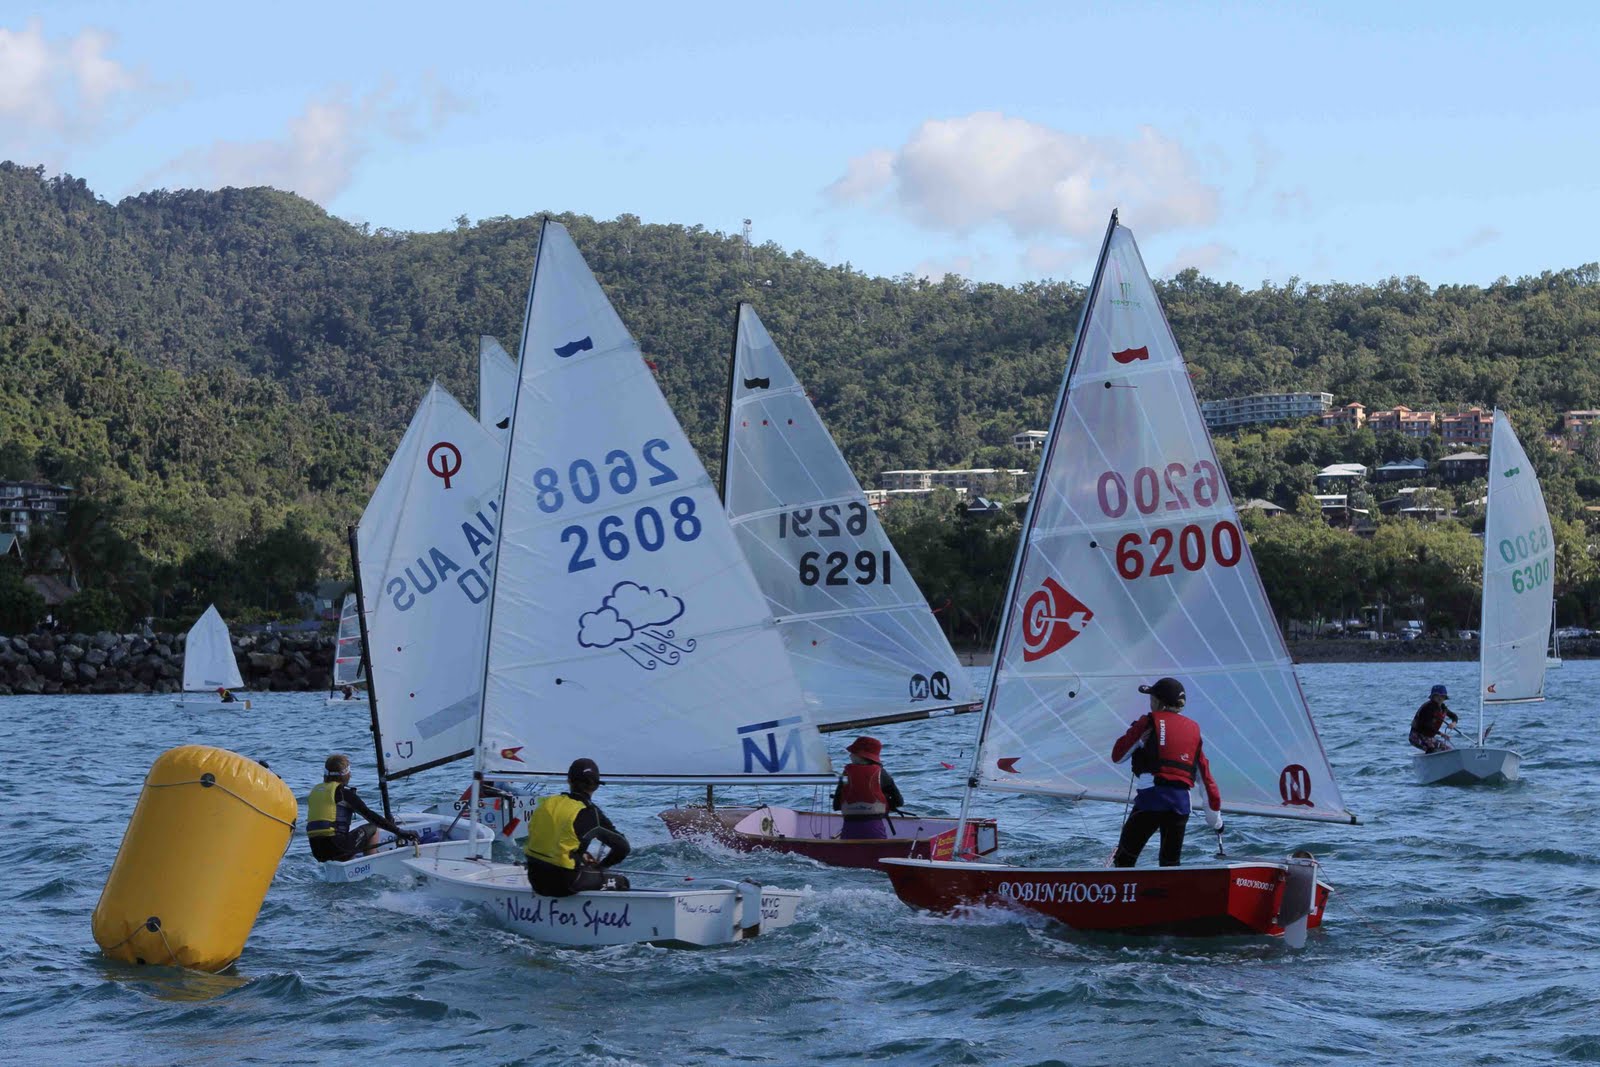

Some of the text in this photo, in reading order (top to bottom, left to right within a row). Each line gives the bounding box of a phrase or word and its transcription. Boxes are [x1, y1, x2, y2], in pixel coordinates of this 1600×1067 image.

[560, 496, 701, 573] 2608
[1116, 520, 1242, 580] 6200
[799, 550, 891, 586] 6291
[1512, 557, 1550, 594] 6300
[507, 896, 543, 923] Need
[548, 898, 578, 927] For
[582, 900, 632, 936] Speed
